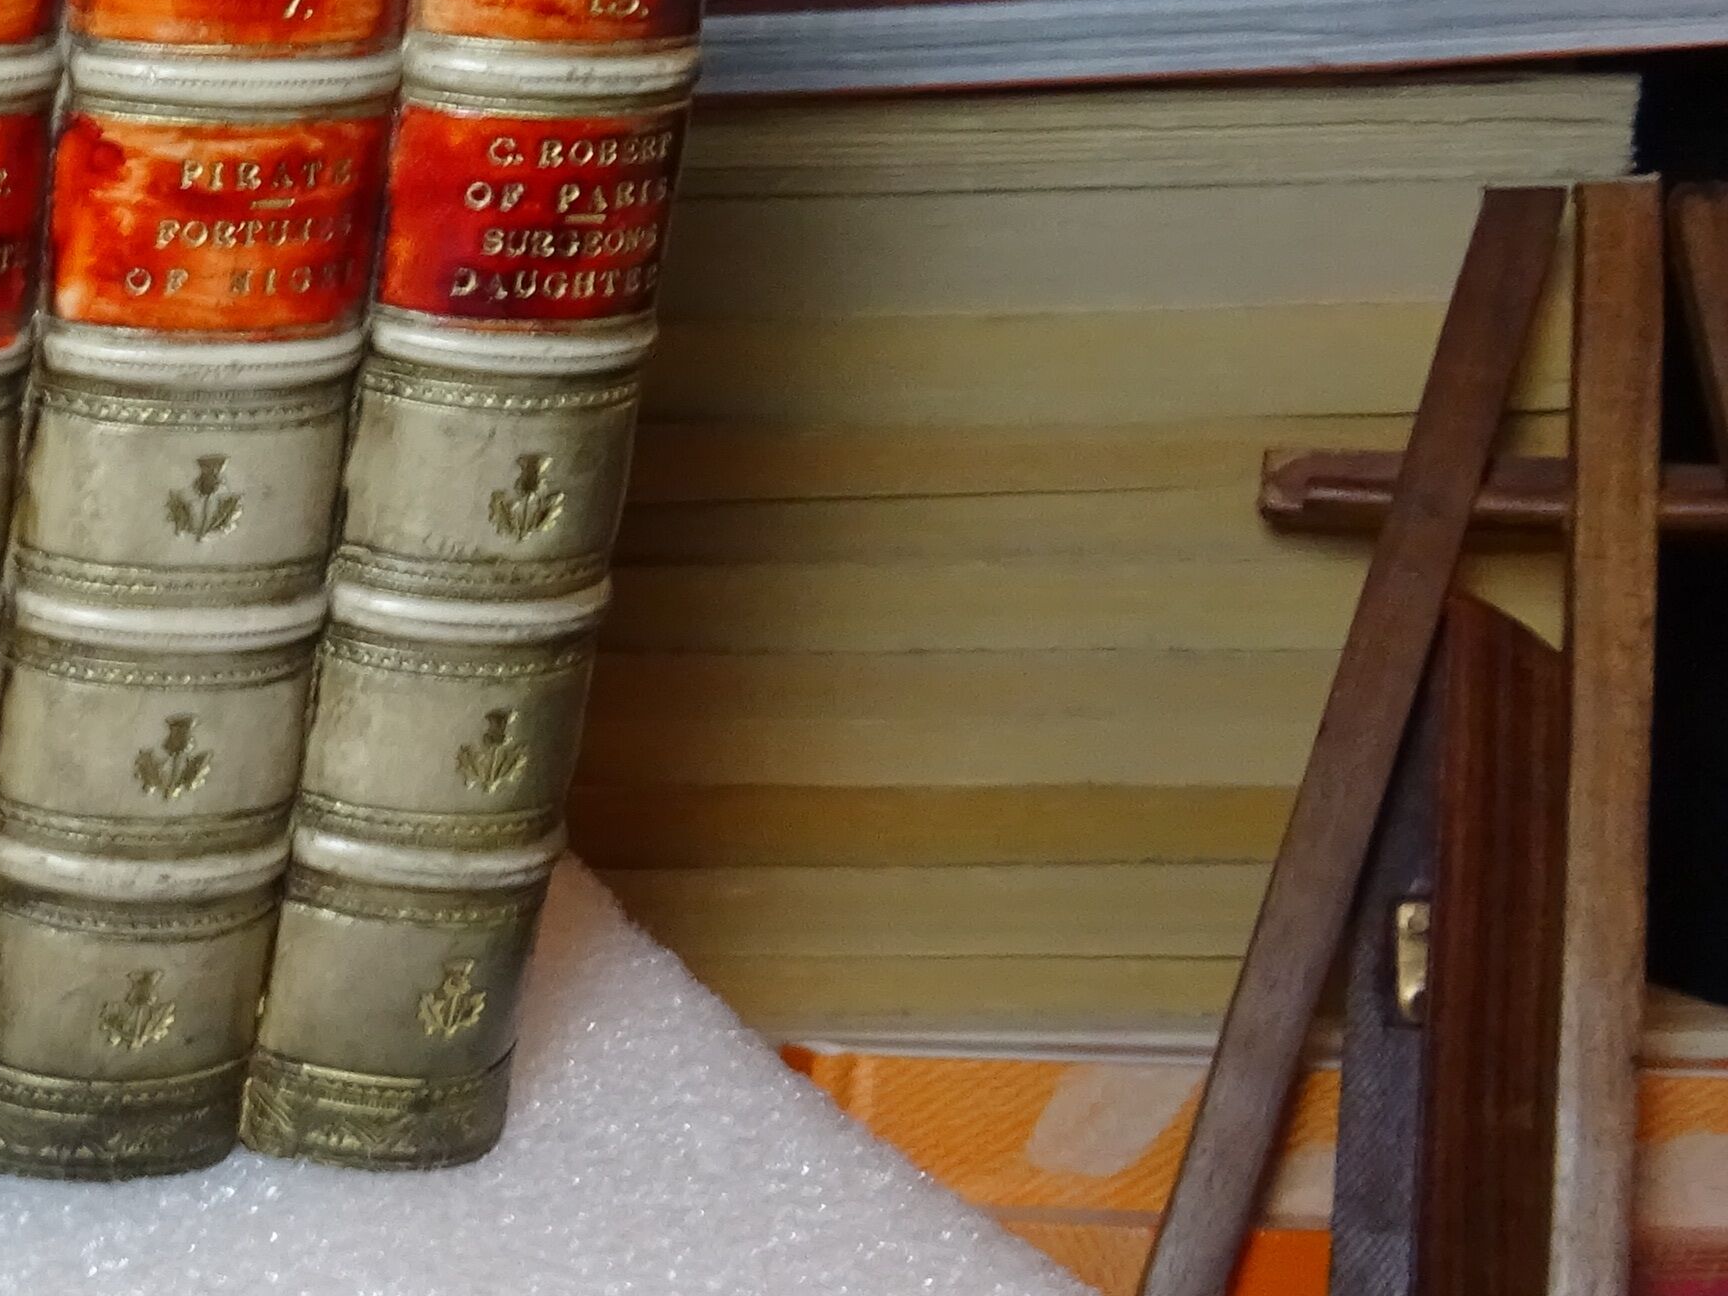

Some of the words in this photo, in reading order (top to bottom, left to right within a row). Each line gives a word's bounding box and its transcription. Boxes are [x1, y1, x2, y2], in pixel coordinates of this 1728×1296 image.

[538, 131, 673, 169] ROBERT
[180, 158, 353, 192] PIRATE
[465, 180, 525, 212] OF
[557, 178, 669, 214] PARIS
[124, 267, 190, 297] OF
